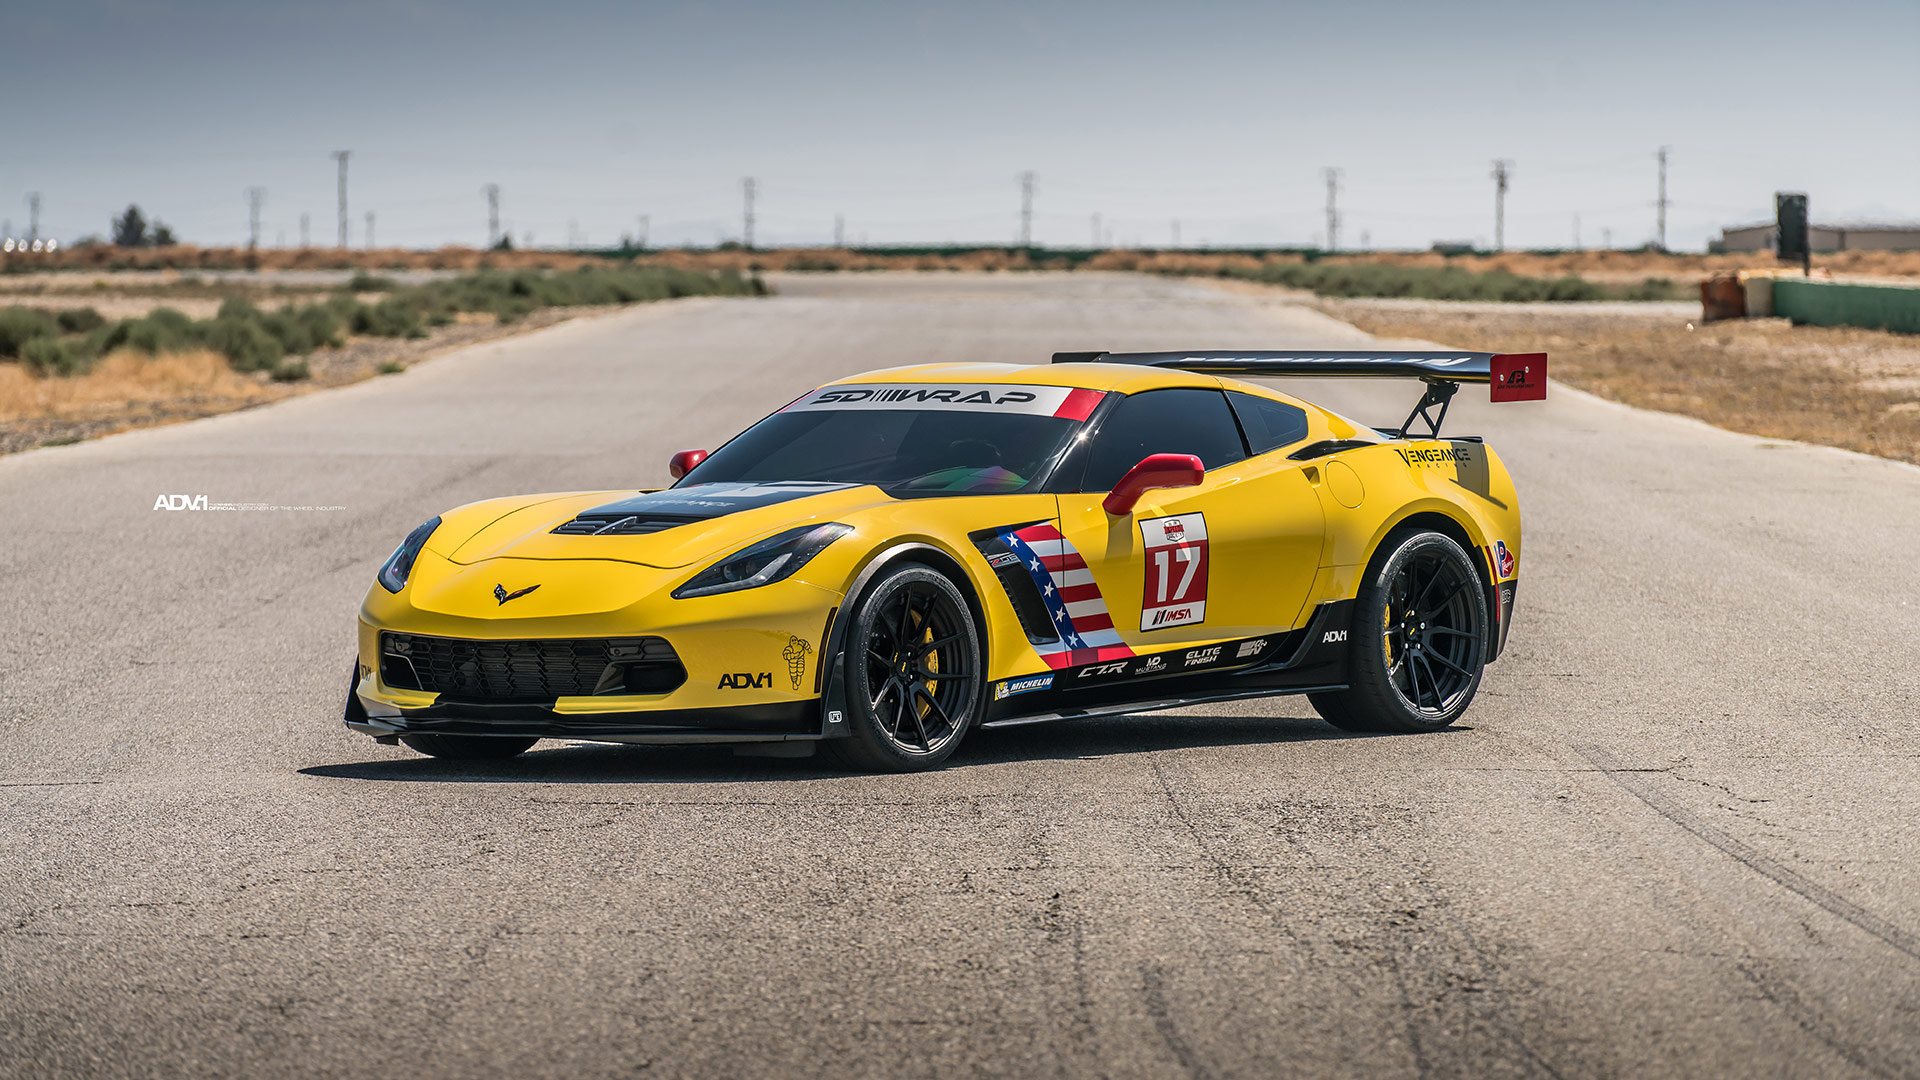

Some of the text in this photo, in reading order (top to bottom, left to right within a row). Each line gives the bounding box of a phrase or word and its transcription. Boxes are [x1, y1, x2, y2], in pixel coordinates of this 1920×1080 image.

[1393, 447, 1472, 468] VENGEANCE
[1155, 546, 1201, 603] 17
[1164, 608, 1192, 622] IMSA
[1185, 646, 1222, 659] ELITE
[1184, 655, 1218, 667] FINISH
[1010, 677, 1053, 691] MICHELIN
